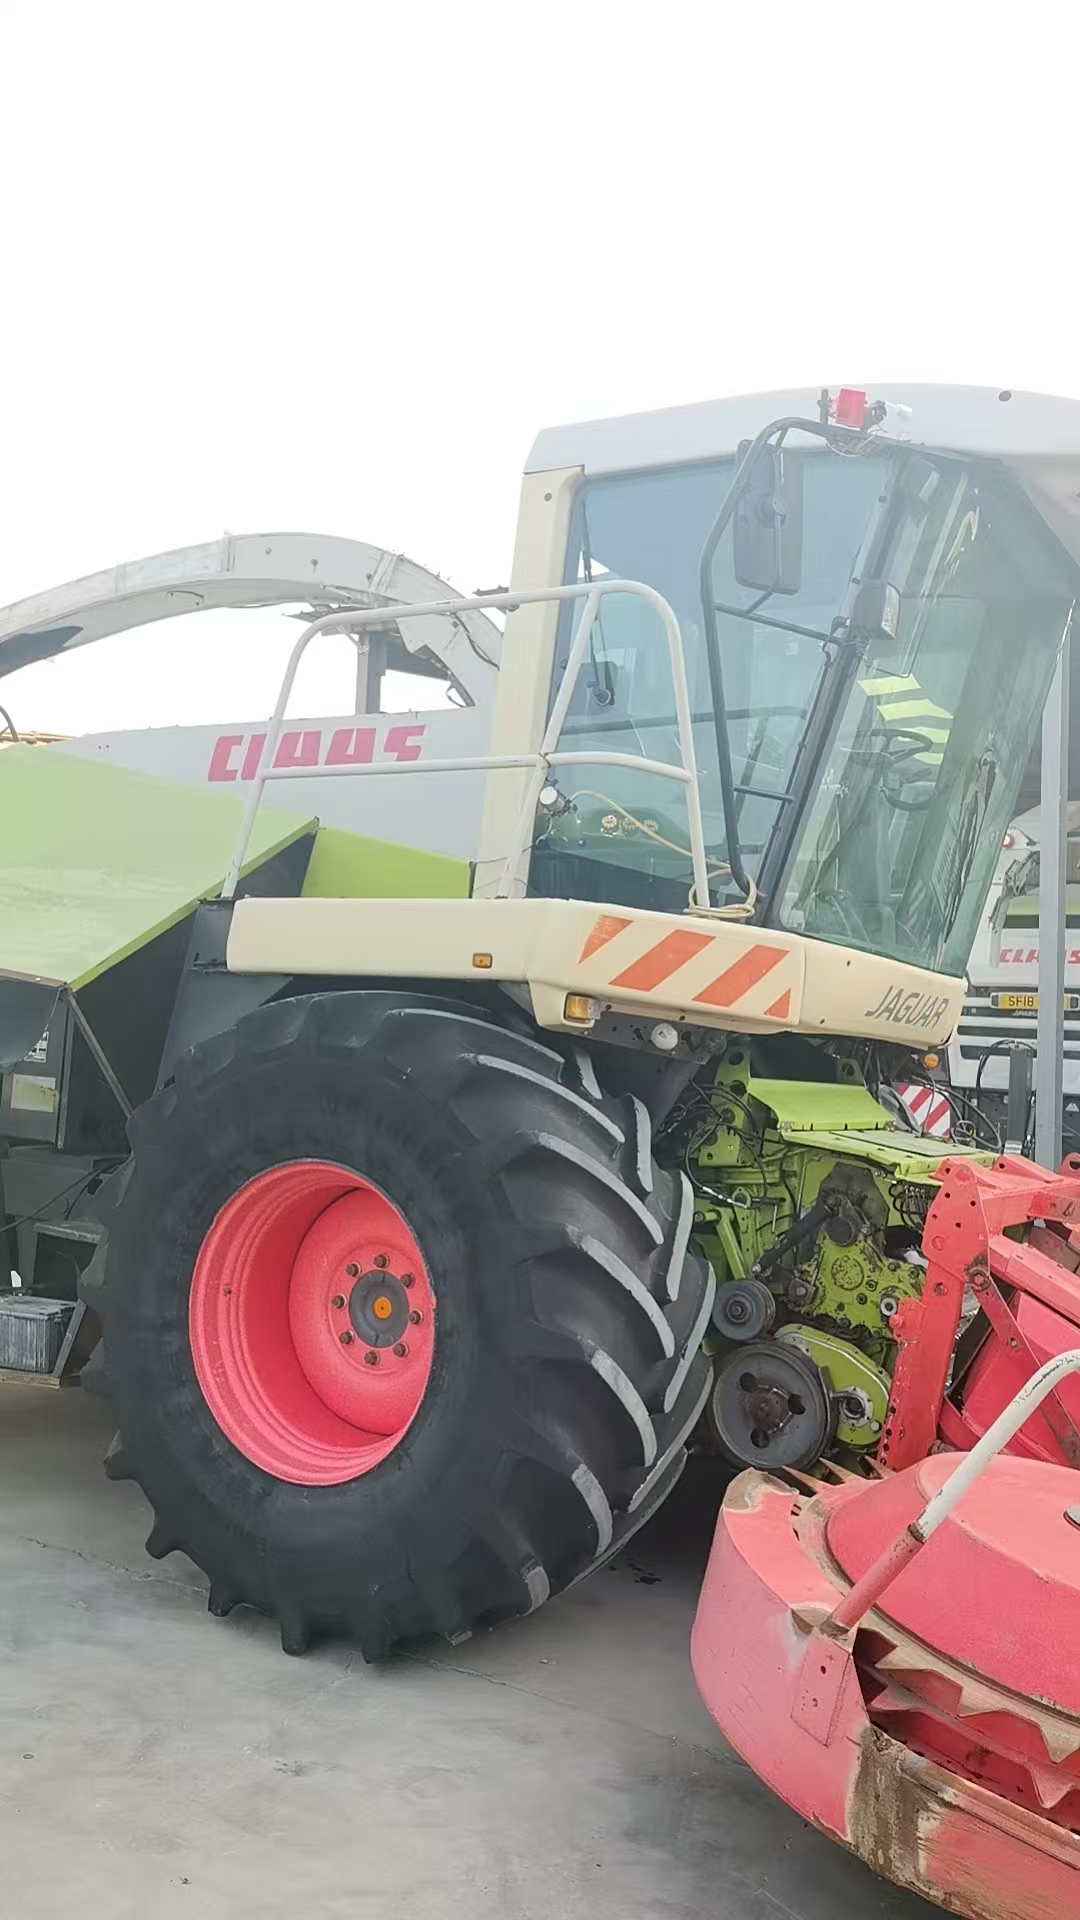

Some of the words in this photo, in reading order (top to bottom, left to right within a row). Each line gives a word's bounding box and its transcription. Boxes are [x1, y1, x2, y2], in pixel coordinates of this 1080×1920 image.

[208, 725, 425, 782] CLAAS
[999, 949, 1080, 964] CLAS
[864, 986, 949, 1029] JAGUAR
